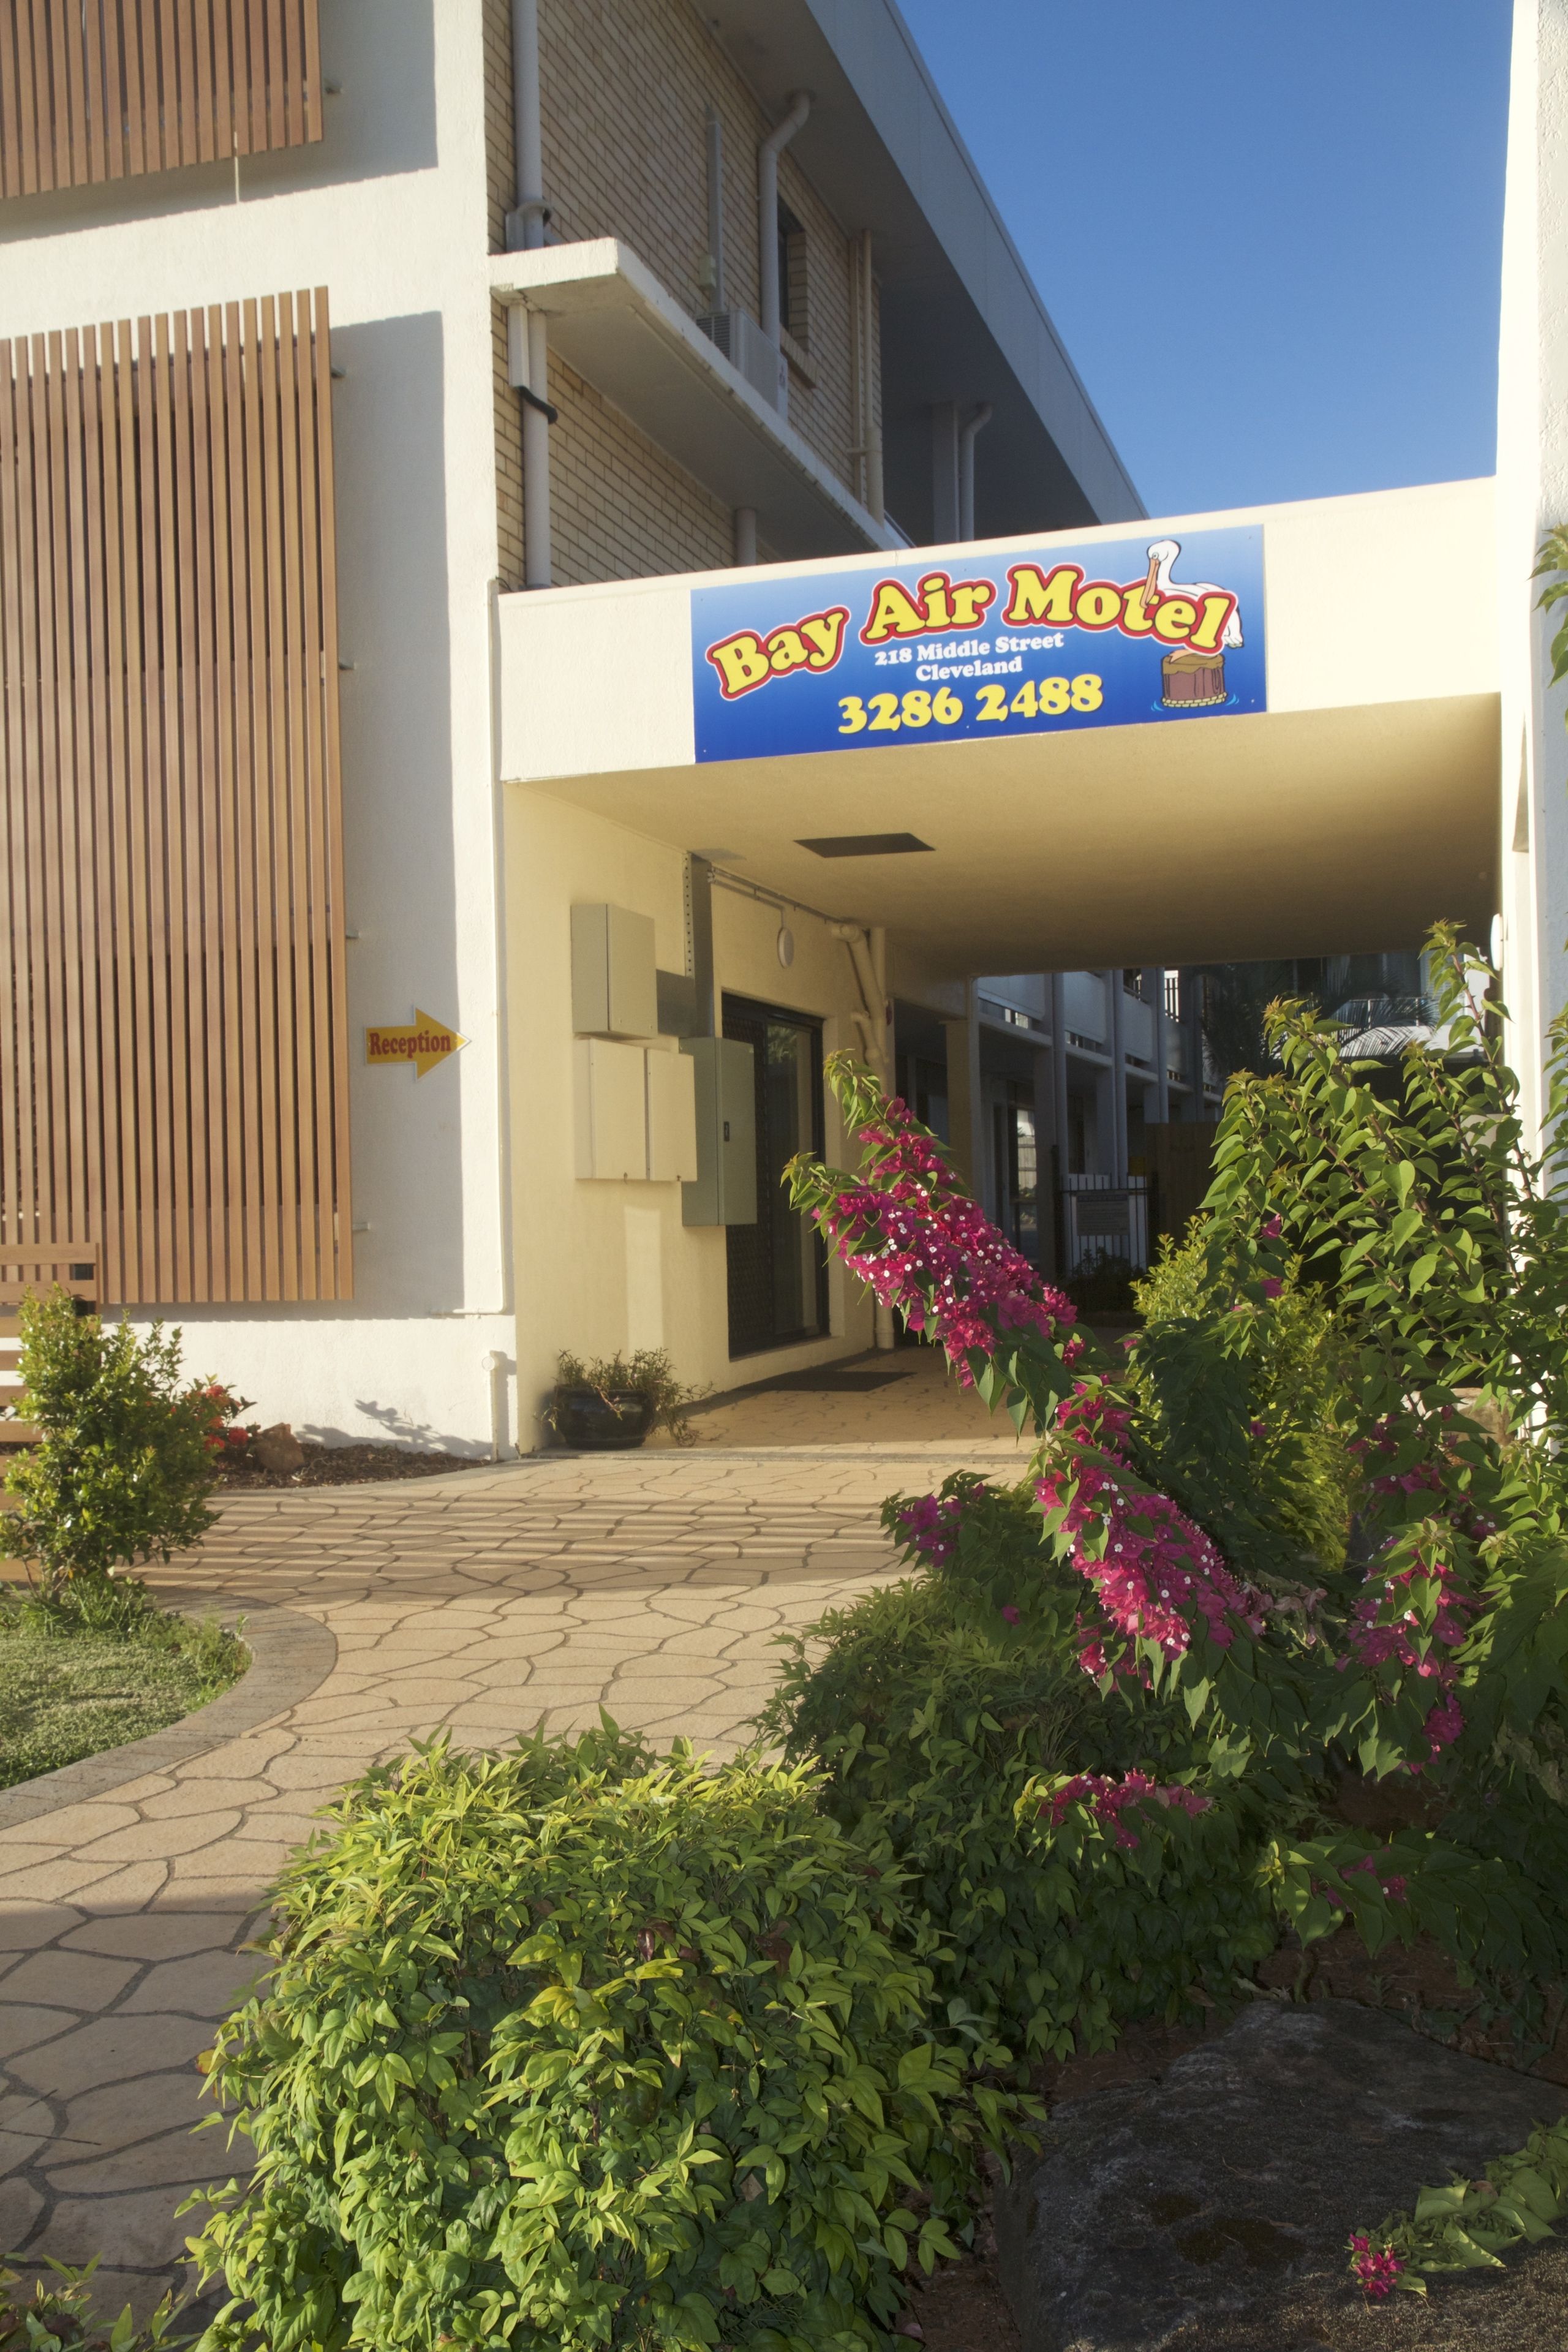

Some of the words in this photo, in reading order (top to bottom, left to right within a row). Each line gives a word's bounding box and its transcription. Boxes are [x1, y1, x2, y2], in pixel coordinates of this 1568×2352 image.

[710, 611, 848, 695] Bay
[865, 578, 992, 641] Air
[1007, 569, 1231, 650] Motel
[874, 646, 913, 666] 218
[916, 639, 990, 662] Middle
[995, 631, 1065, 654] Street
[915, 655, 1023, 682] Cleveland
[838, 686, 964, 734] 3286
[975, 674, 1103, 722] 2488
[369, 1030, 451, 1058] Reception
